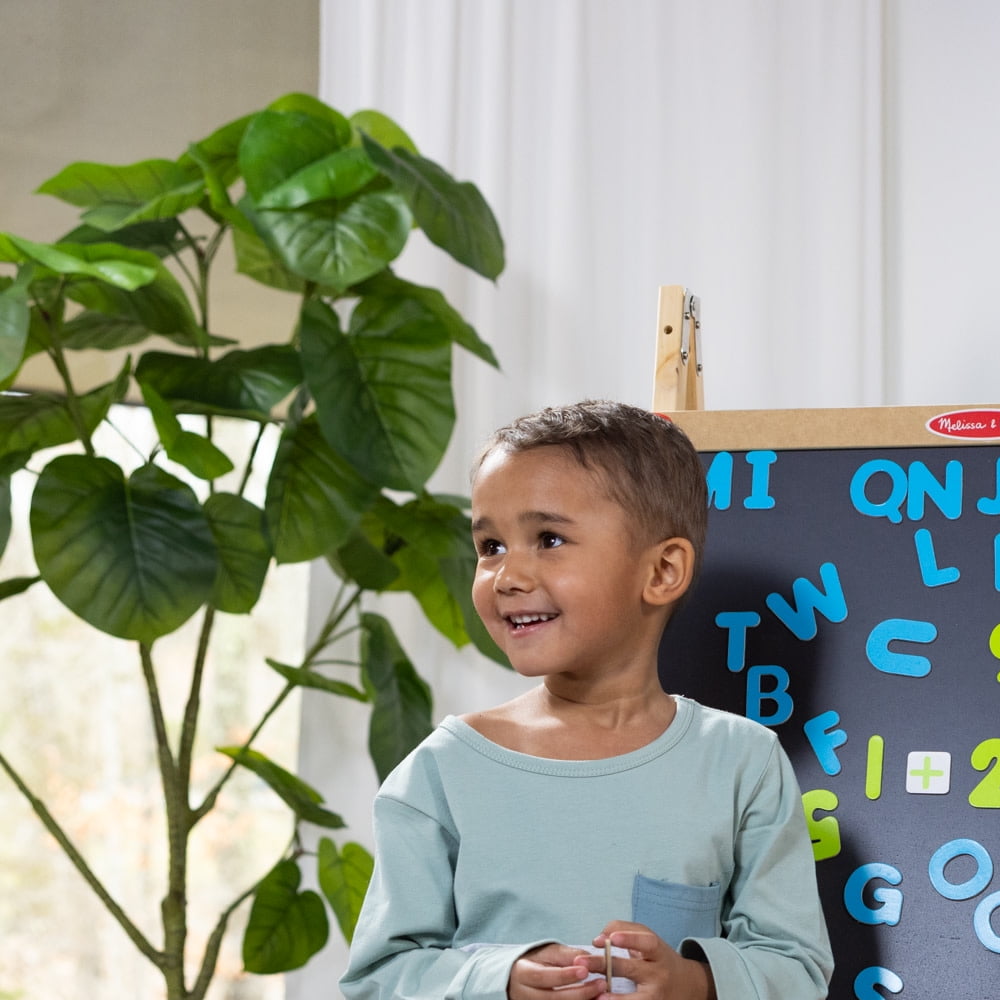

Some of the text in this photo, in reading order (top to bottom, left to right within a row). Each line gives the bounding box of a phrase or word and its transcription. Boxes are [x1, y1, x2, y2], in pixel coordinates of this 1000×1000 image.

[938, 418, 987, 432] Melissa
[914, 528, 961, 588] L
[765, 561, 849, 641] W
[715, 611, 761, 673] T
[745, 665, 794, 726] B
[803, 710, 848, 776] F
[844, 862, 904, 927] G
